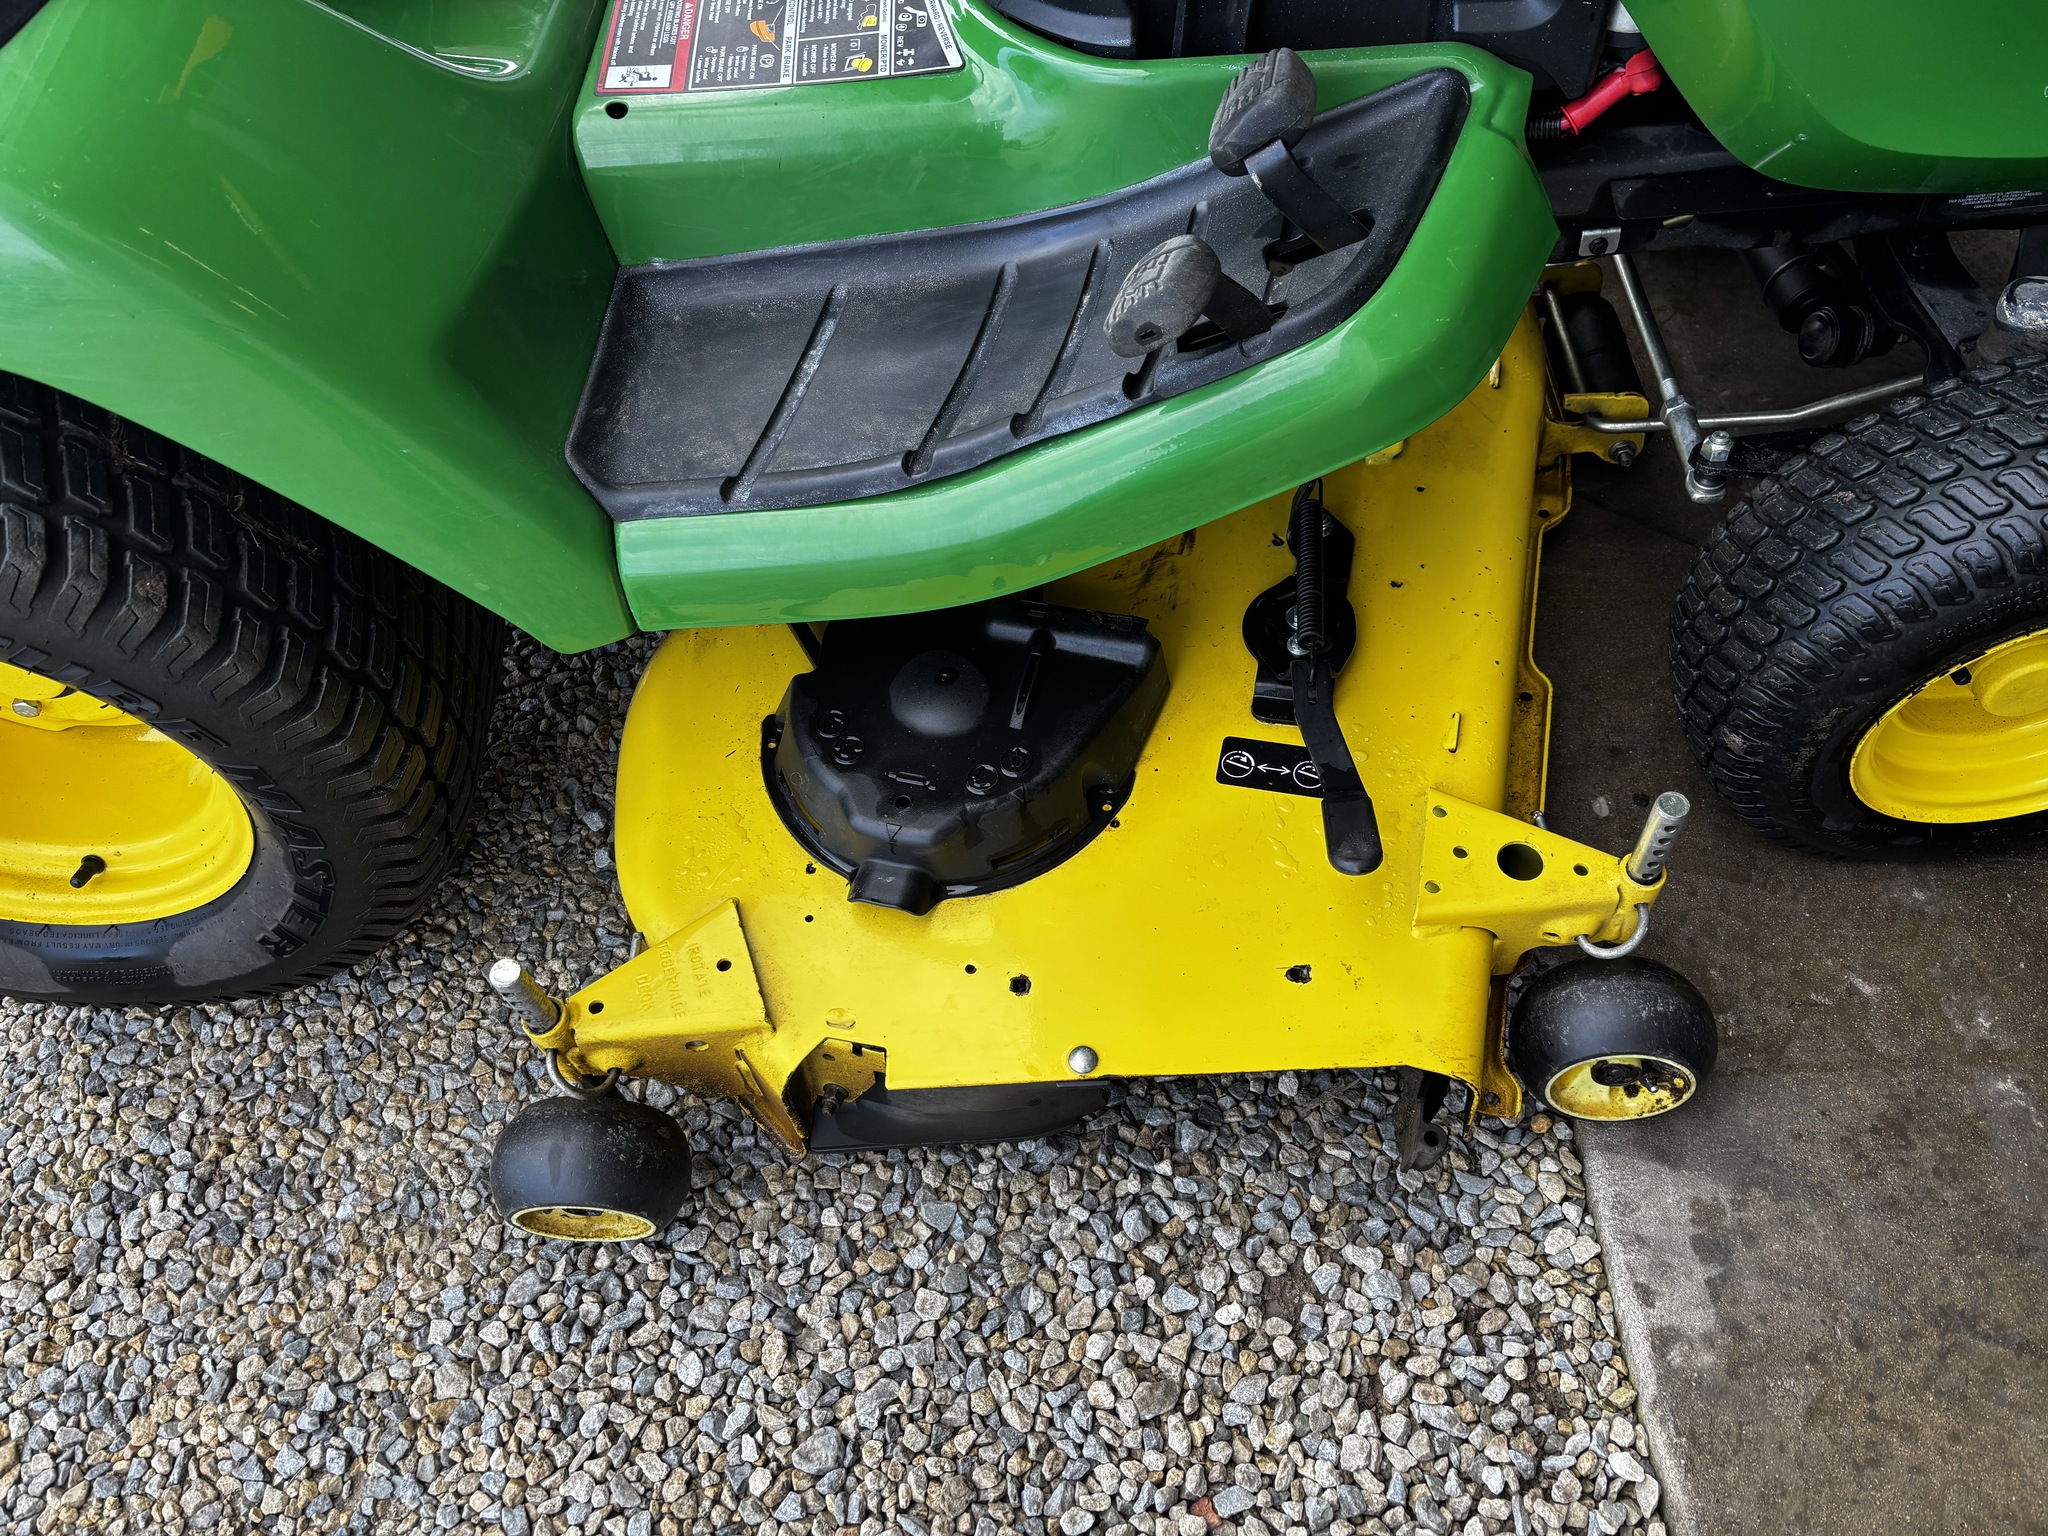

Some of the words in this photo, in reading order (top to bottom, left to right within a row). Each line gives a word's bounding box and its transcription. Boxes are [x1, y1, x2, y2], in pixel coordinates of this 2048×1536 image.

[672, 18, 680, 36] BLADES
[680, 8, 693, 40] DANGER
[670, 35, 678, 45] CUT
[896, 35, 904, 48] REV
[937, 22, 952, 50] REVERSE
[785, 36, 793, 54] PARK
[783, 55, 791, 79] BRAKE
[830, 63, 836, 72] ON
[749, 72, 756, 80] ON
[0, 637, 231, 749] URF
[216, 762, 336, 959] MASTER
[9, 927, 41, 938] BEADS
[42, 931, 100, 939] LUBRICATED
[14, 938, 42, 948] FROM
[45, 941, 80, 949] RESULT
[82, 941, 101, 949] MAY
[686, 943, 711, 998] ROTATE
